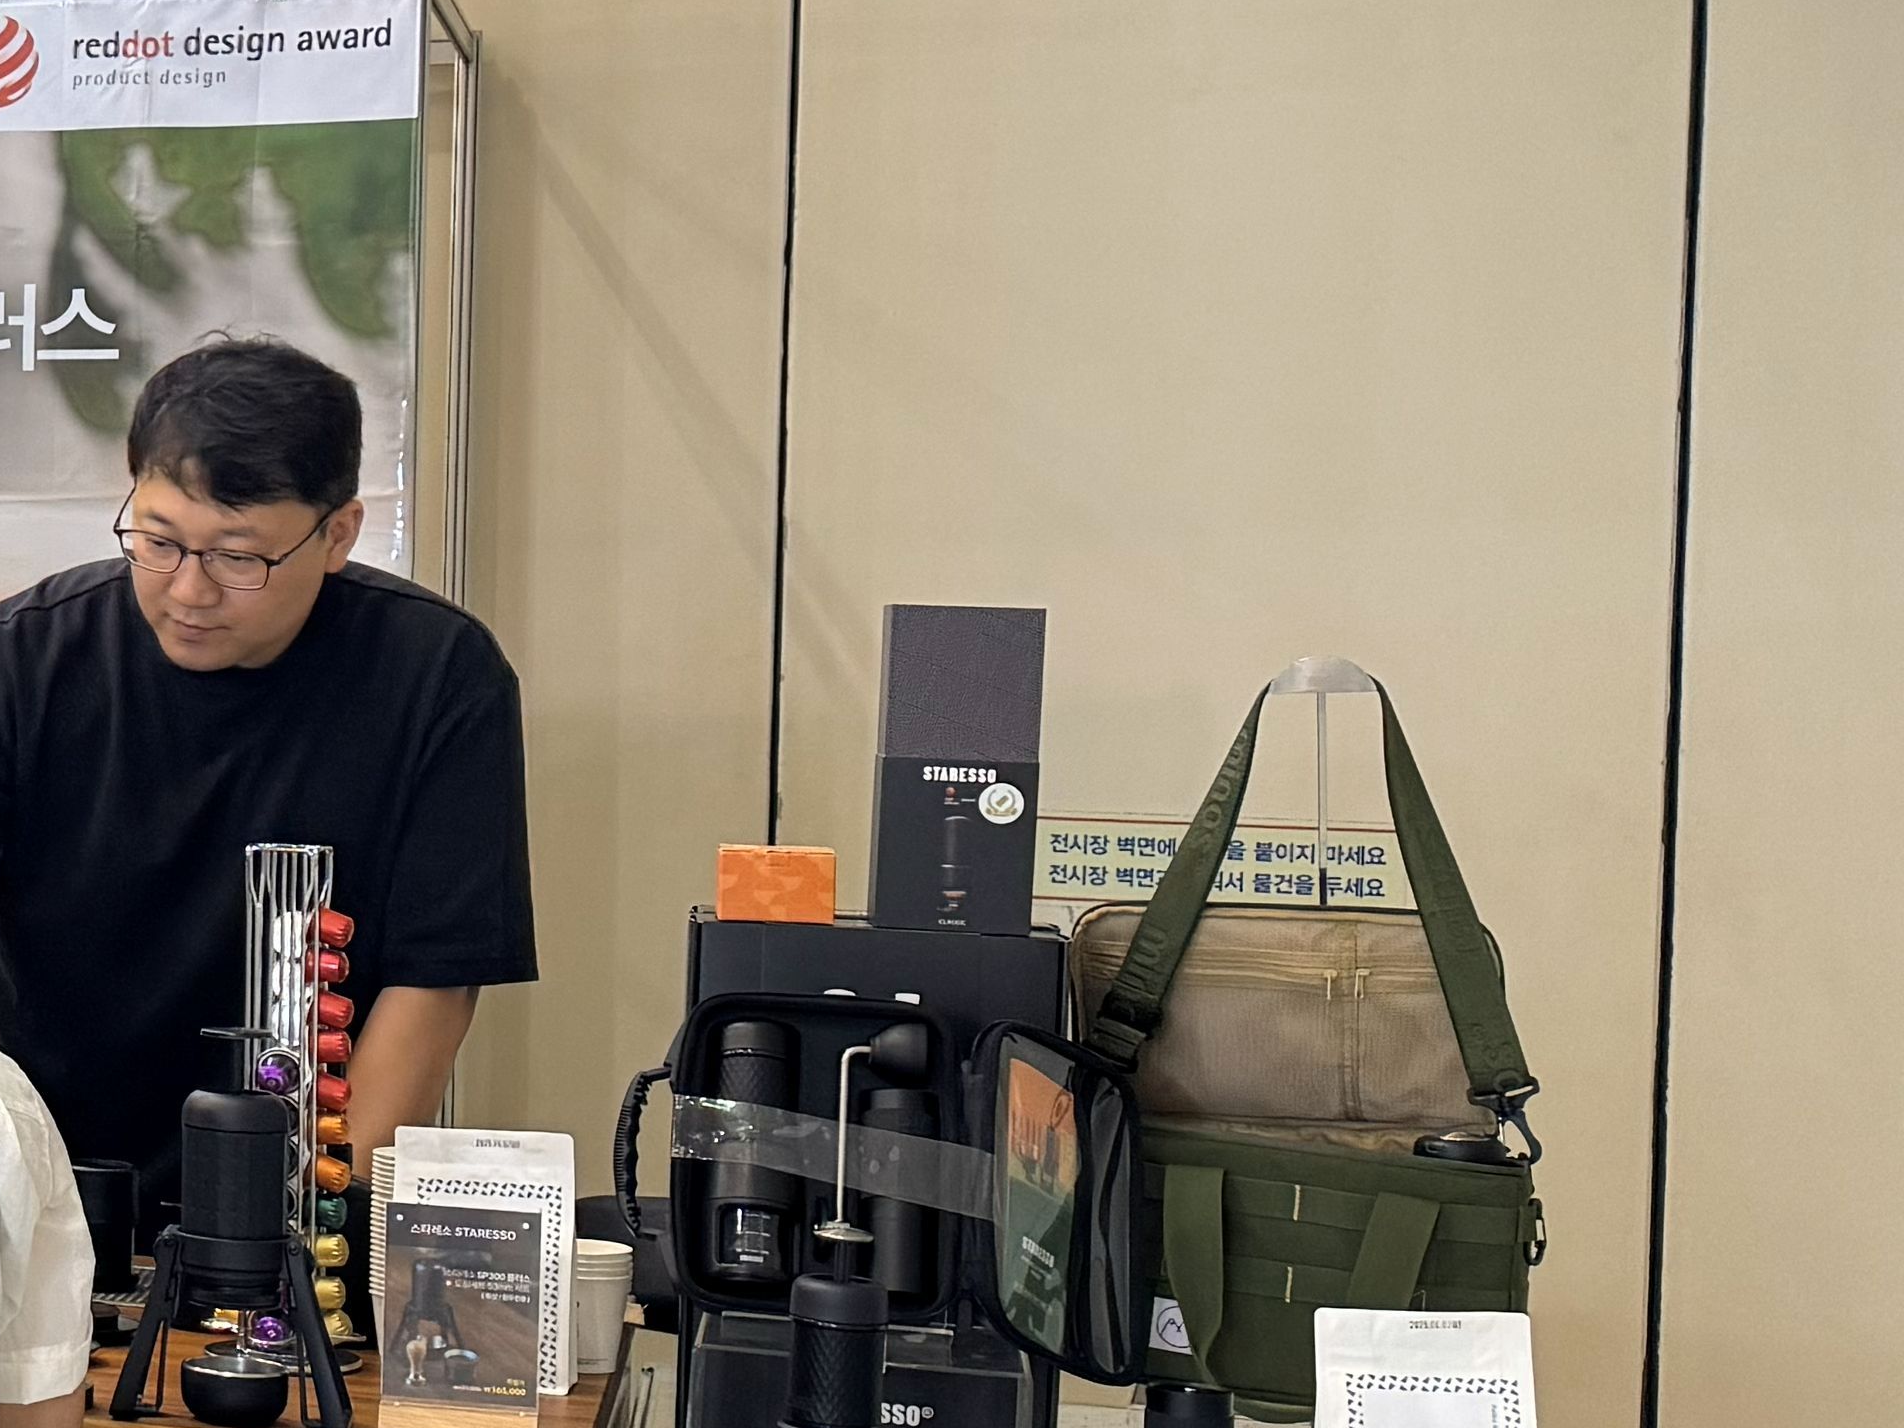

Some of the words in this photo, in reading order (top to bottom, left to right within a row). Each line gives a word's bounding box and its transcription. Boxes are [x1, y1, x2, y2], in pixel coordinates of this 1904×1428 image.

[73, 29, 175, 60] reddot
[183, 25, 285, 62] design
[296, 17, 392, 53] award
[72, 70, 152, 91] product
[159, 67, 227, 89] design
[922, 765, 998, 785] STARESSO
[1048, 833, 1110, 856] 전시장
[1116, 836, 1179, 860] 벽면에
[1225, 839, 1248, 862] 을
[1326, 845, 1387, 867] 마세요
[1048, 864, 1108, 887] 전시장
[1252, 872, 1316, 896] 물건을
[410, 1222, 453, 1238] 스타레소
[455, 1226, 517, 1242] STARESSO
